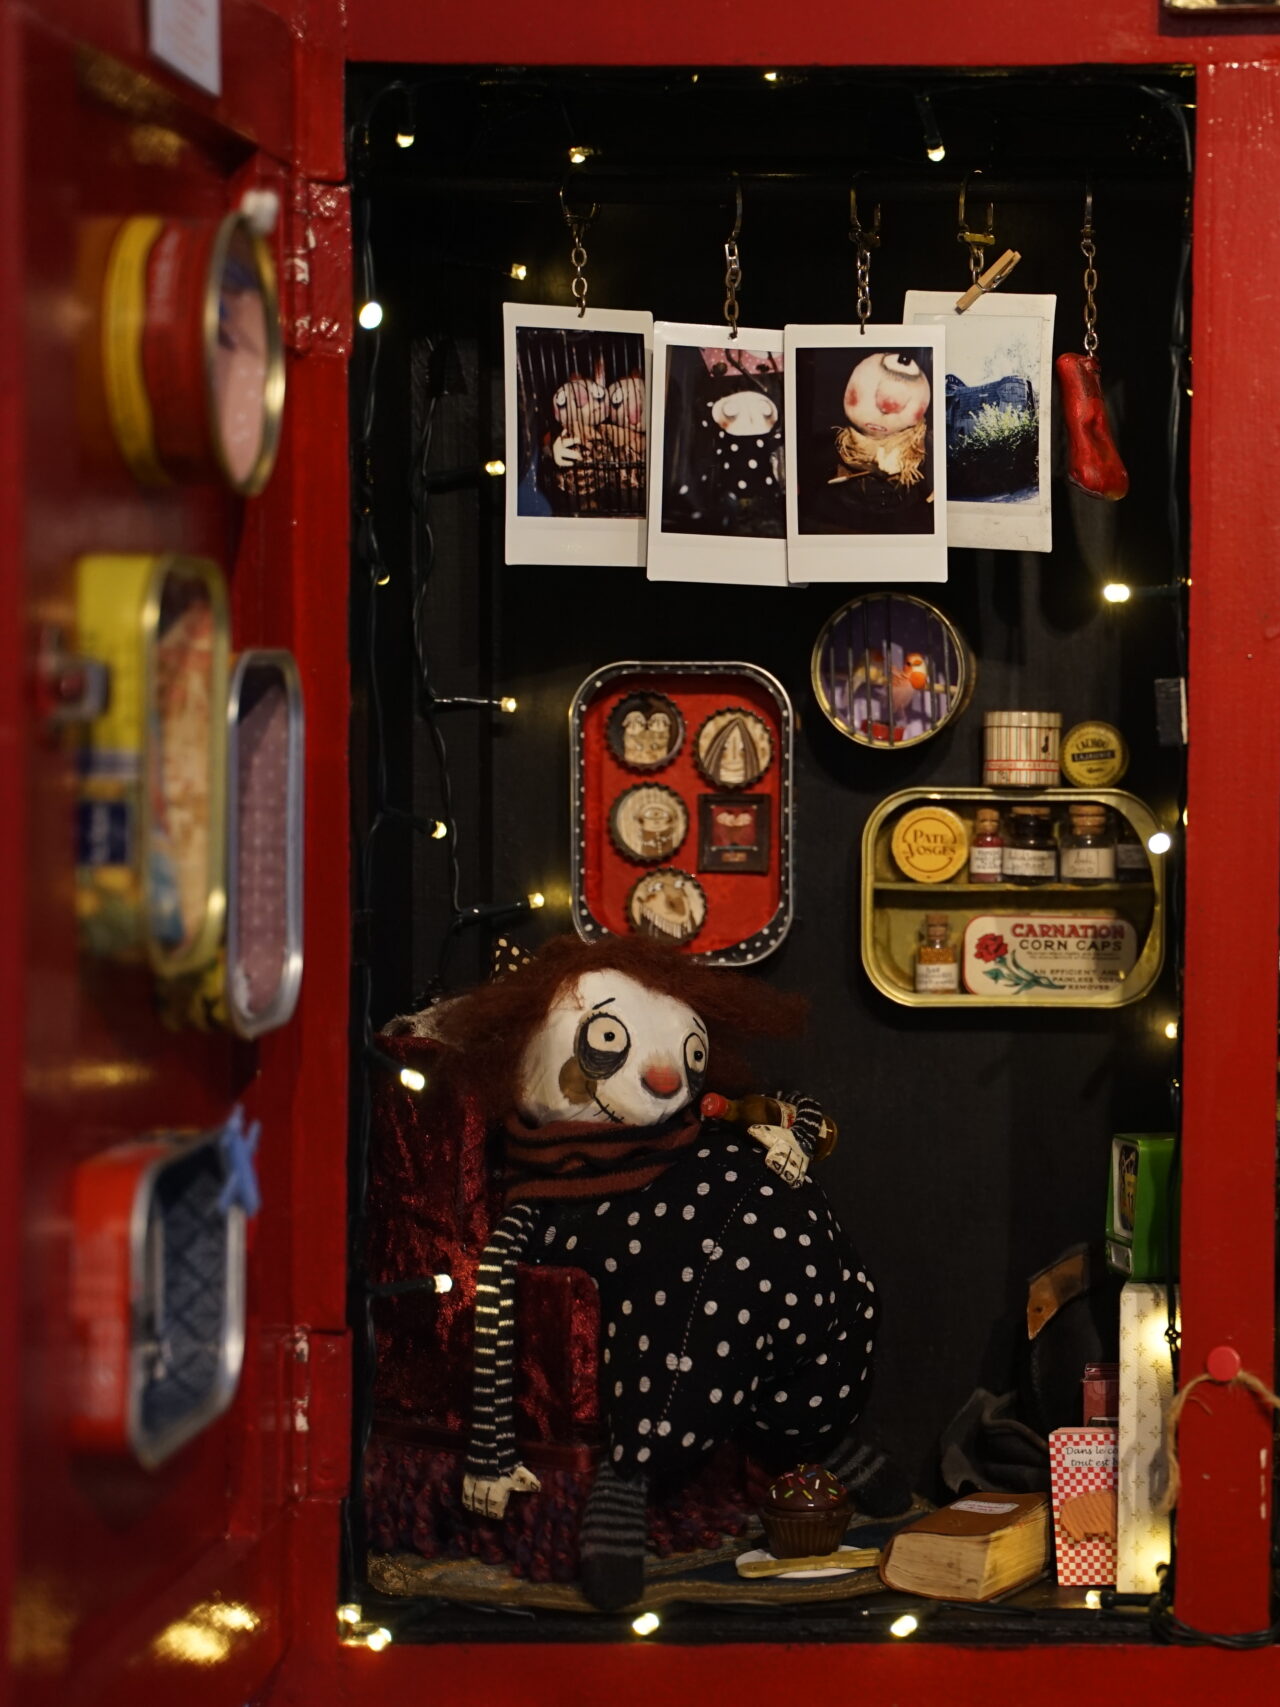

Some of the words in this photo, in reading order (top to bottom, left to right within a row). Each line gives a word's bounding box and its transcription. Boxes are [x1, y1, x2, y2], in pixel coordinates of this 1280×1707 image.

[1012, 923, 1125, 939] CARNATION
[1019, 939, 1068, 951] CORN
[1075, 939, 1123, 952] CAPS
[1066, 1446, 1093, 1455] Dans
[1096, 1446, 1105, 1454] le
[1071, 1459, 1094, 1467] tout
[1096, 1459, 1110, 1467] est
